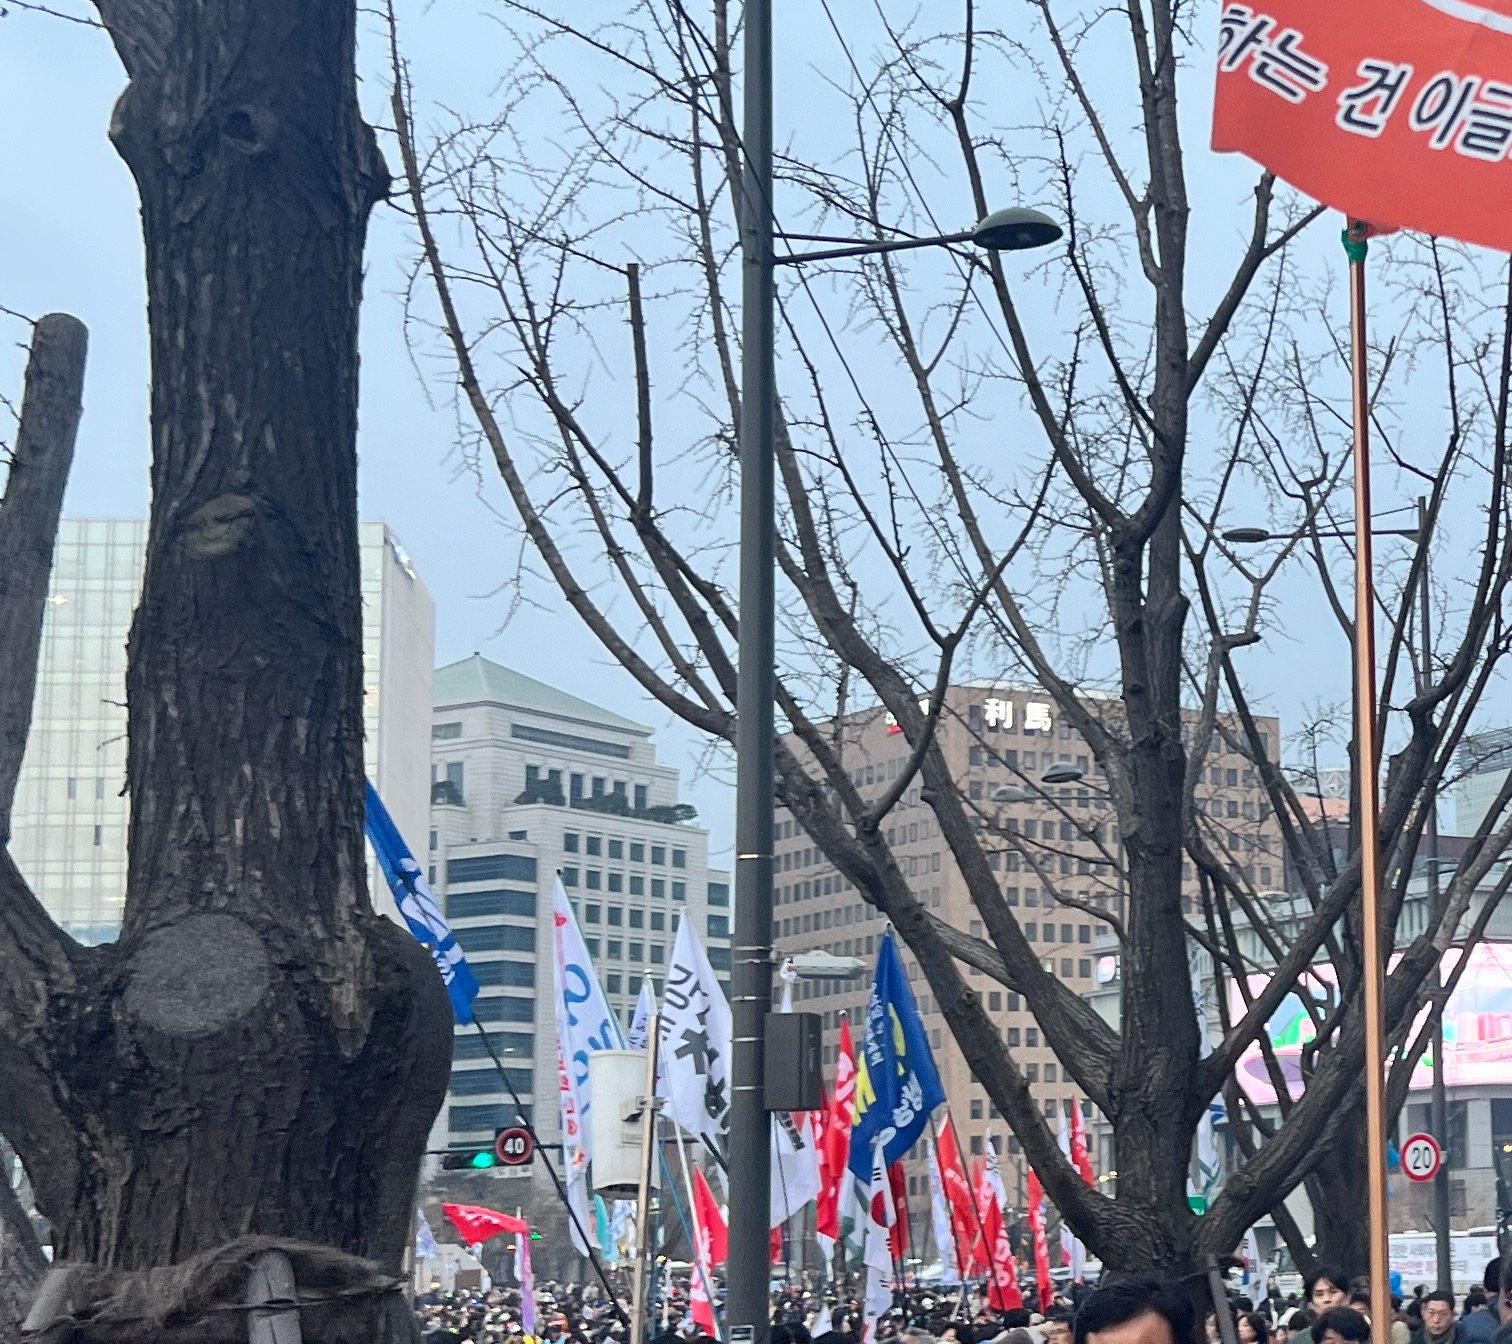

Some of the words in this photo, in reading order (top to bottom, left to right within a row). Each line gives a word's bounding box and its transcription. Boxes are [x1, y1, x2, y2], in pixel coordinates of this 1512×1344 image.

[1336, 58, 1413, 138] 건
[504, 1137, 525, 1154] 40
[1412, 1146, 1432, 1169] 20
